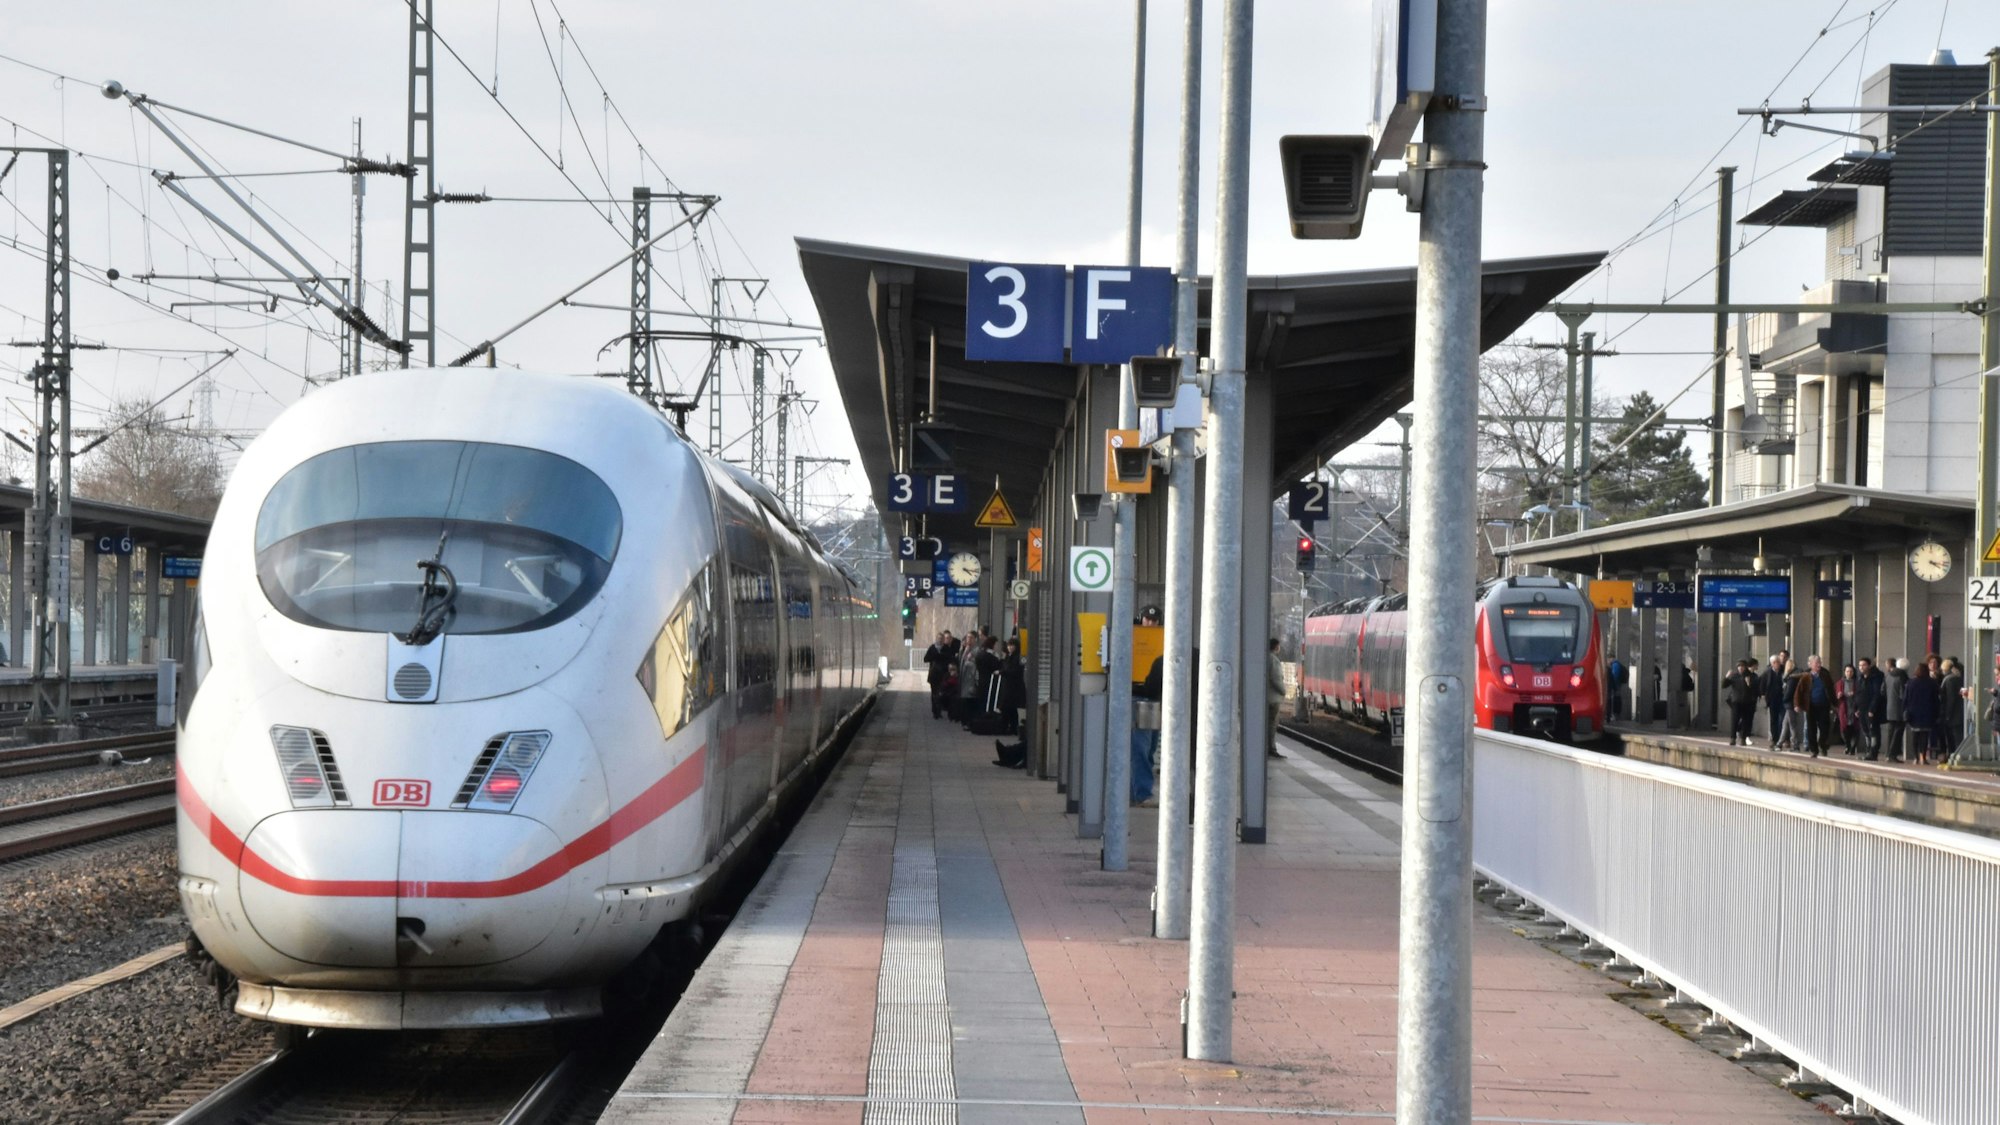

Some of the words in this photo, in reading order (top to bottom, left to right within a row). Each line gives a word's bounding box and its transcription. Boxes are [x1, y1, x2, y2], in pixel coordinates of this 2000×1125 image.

[981, 266, 1028, 338] 3
[1086, 270, 1131, 340] F
[893, 474, 912, 503] 3
[935, 475, 954, 504] E
[1304, 483, 1323, 511] 2
[100, 537, 110, 551] C
[121, 537, 131, 552] 6
[902, 536, 914, 555] 3
[908, 578, 915, 589] 3
[922, 578, 931, 589] B
[1656, 582, 1676, 594] 2-3
[1687, 582, 1695, 594] 6
[1971, 580, 1999, 600] 24
[1978, 606, 1991, 623] 4
[1535, 677, 1551, 686] DB
[379, 782, 425, 803] DB
